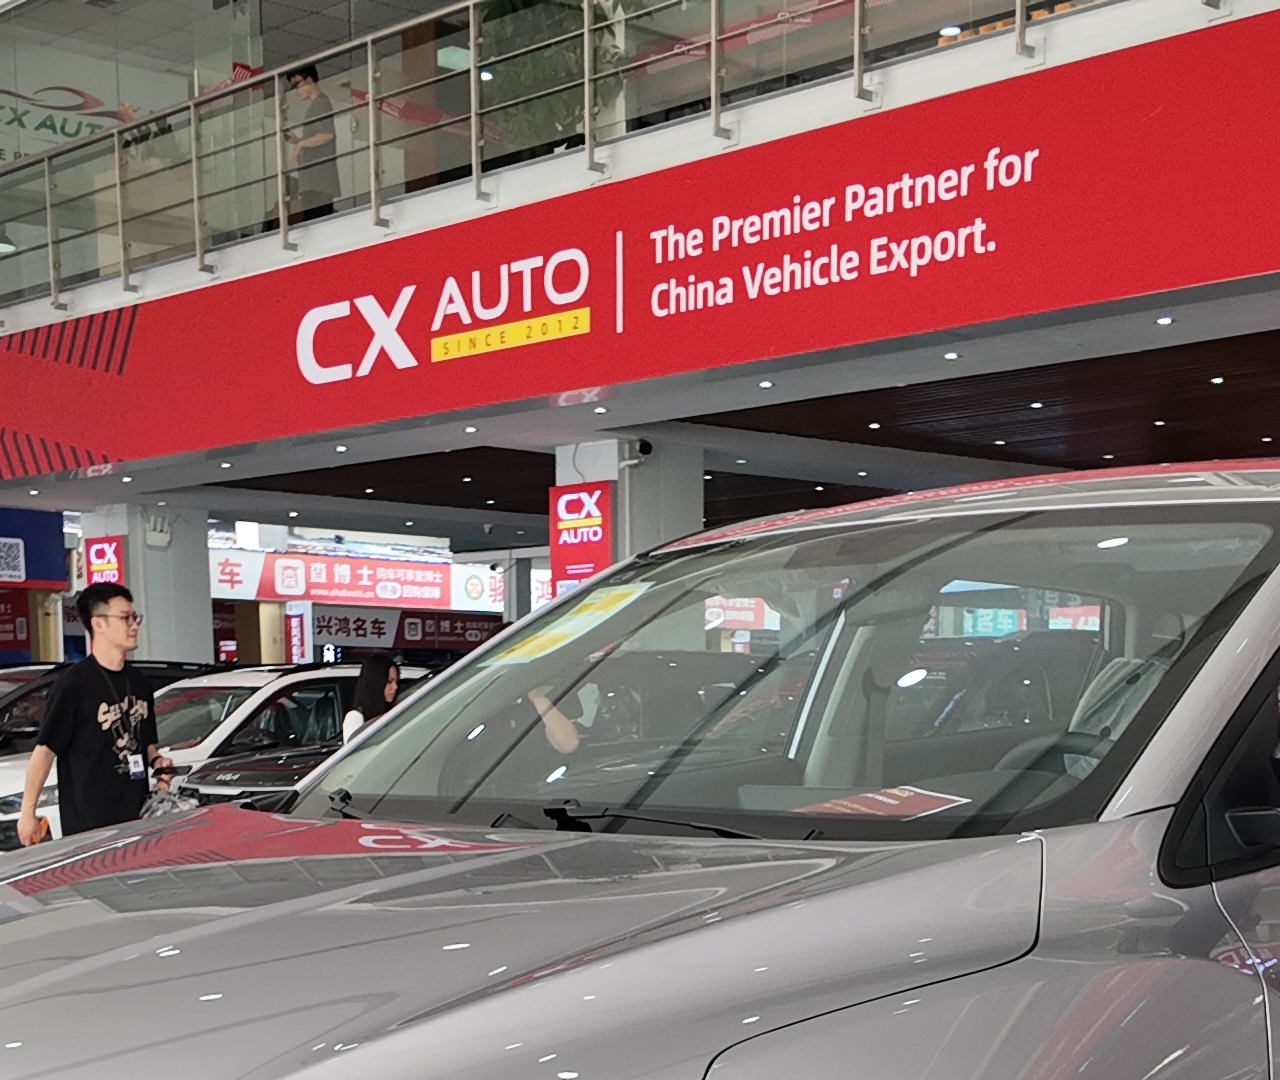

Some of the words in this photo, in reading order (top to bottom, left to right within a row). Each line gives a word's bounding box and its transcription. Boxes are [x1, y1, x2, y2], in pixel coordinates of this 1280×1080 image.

[33, 113, 105, 138] AUT
[650, 224, 703, 263] The
[712, 195, 835, 252] Premier
[845, 163, 974, 222] Partner
[984, 147, 1040, 190] for
[651, 274, 733, 317] China
[743, 244, 859, 299] Vehicle
[869, 217, 997, 277] Export.
[296, 285, 418, 384] CX
[430, 248, 589, 332] AUTO
[442, 331, 506, 355] SINCE
[526, 316, 580, 340] 2012
[557, 490, 602, 520] CX
[558, 526, 603, 545] AUTO
[89, 542, 118, 565] CX
[91, 569, 119, 584] AUTO
[218, 558, 243, 589] 车
[313, 615, 387, 639] 兴鸿名车
